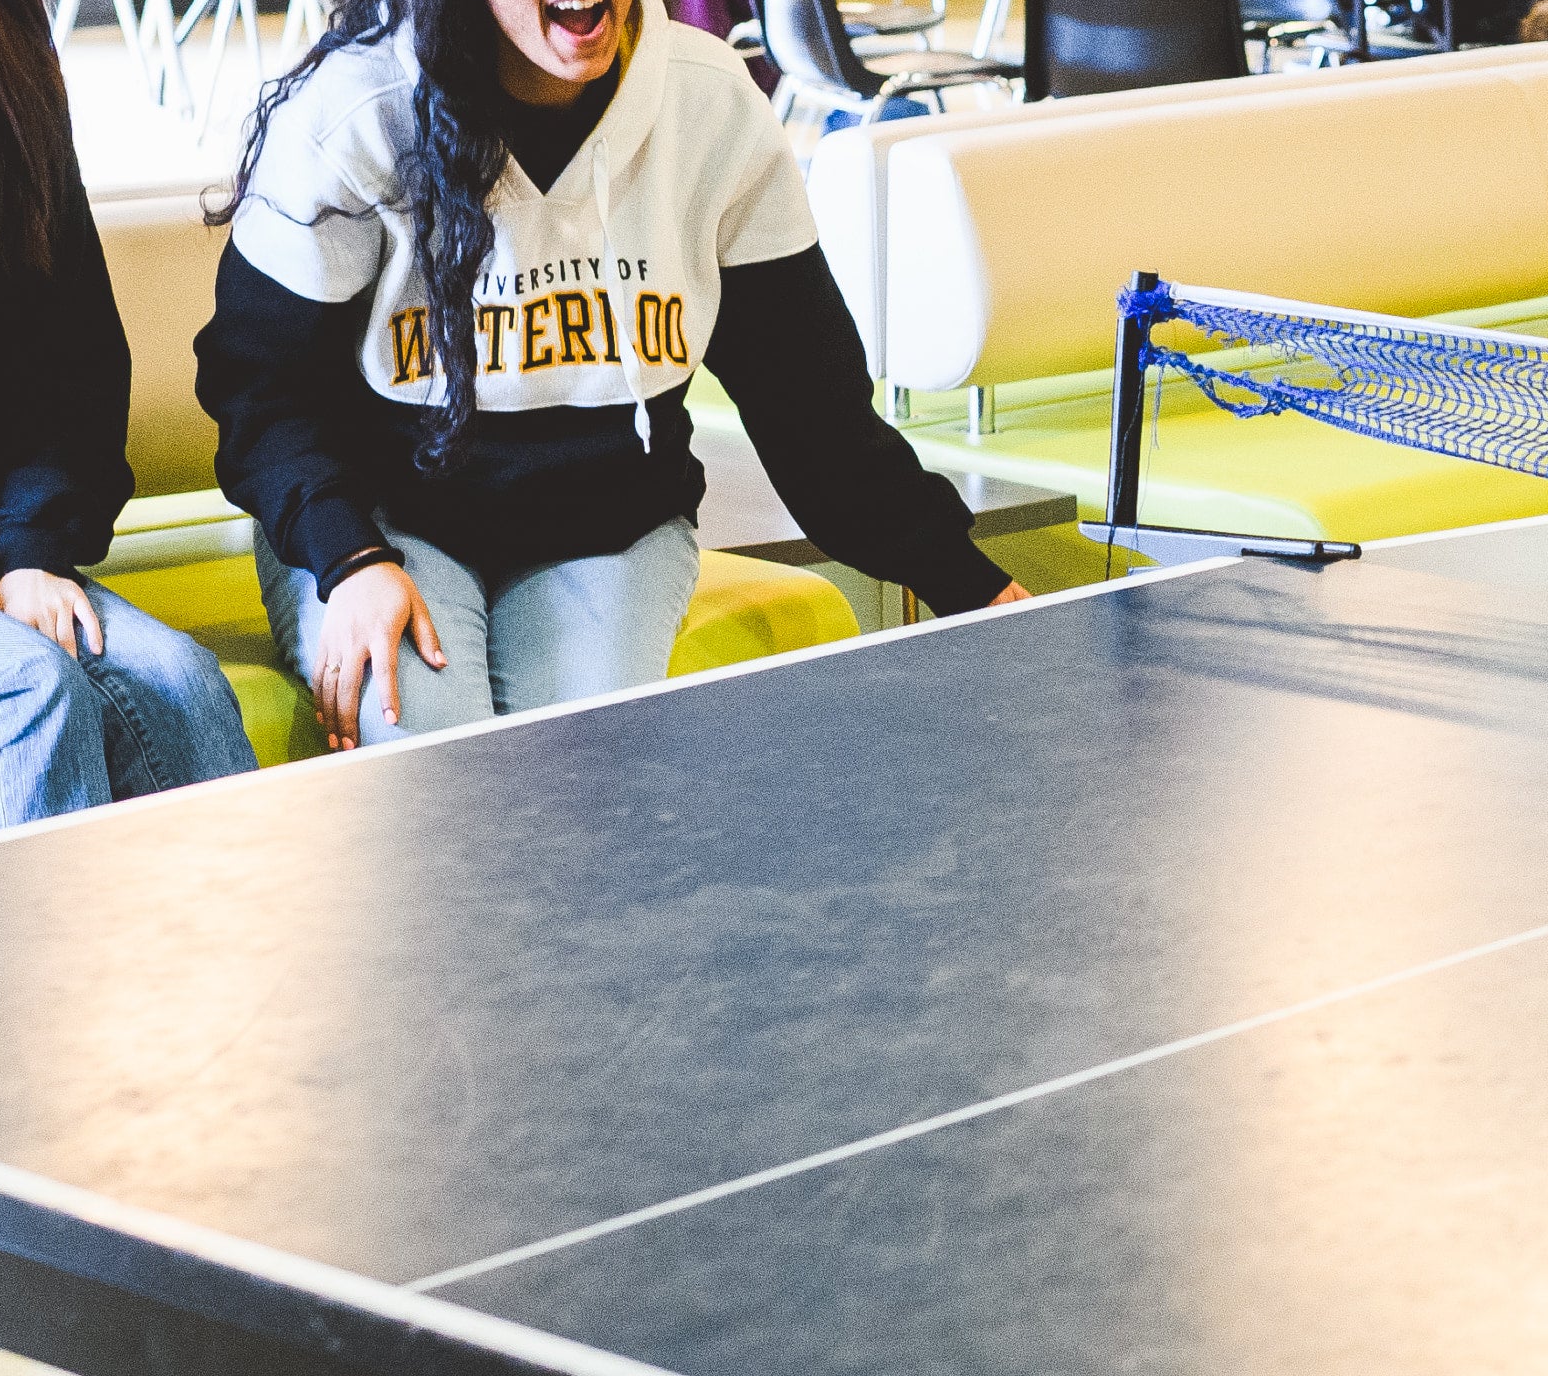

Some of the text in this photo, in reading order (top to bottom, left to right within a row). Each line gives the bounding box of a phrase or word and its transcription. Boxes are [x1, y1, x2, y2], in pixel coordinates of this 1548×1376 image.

[482, 256, 649, 296] IVERSITY OF
[388, 289, 689, 387] WTERLOO
